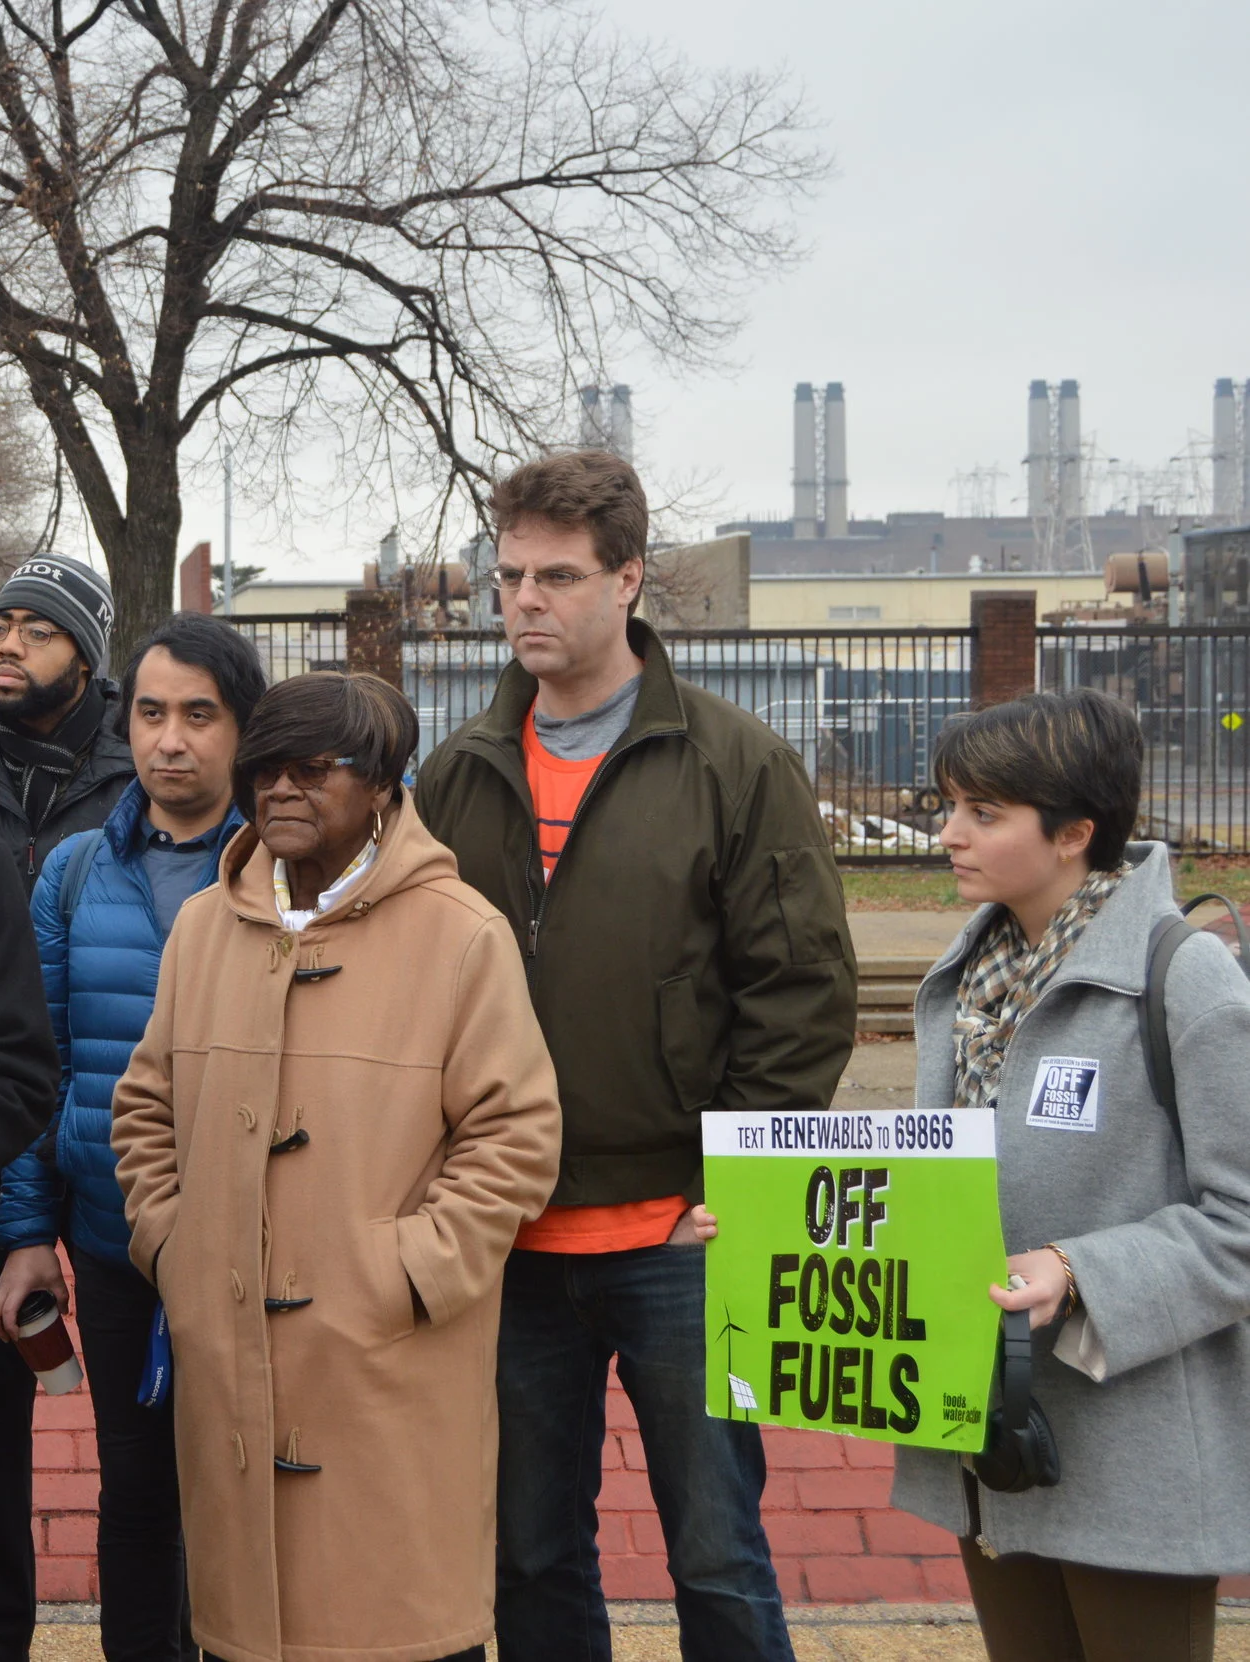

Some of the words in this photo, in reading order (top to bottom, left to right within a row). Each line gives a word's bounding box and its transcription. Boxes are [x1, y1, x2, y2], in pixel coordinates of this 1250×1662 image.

[1047, 1067, 1082, 1091] OFF
[1041, 1102, 1080, 1119] FUELS
[1044, 1090, 1080, 1104] FOSSIL
[737, 1126, 766, 1149] TEXT
[771, 1115, 872, 1150] RENEWABLES
[877, 1126, 890, 1150] TO
[894, 1114, 954, 1150] 69866
[805, 1165, 890, 1250] OFF
[768, 1253, 927, 1341] FOSSIL
[152, 1366, 164, 1397] Tobacco
[769, 1341, 921, 1434] FUELS
[943, 1407, 965, 1422] water
